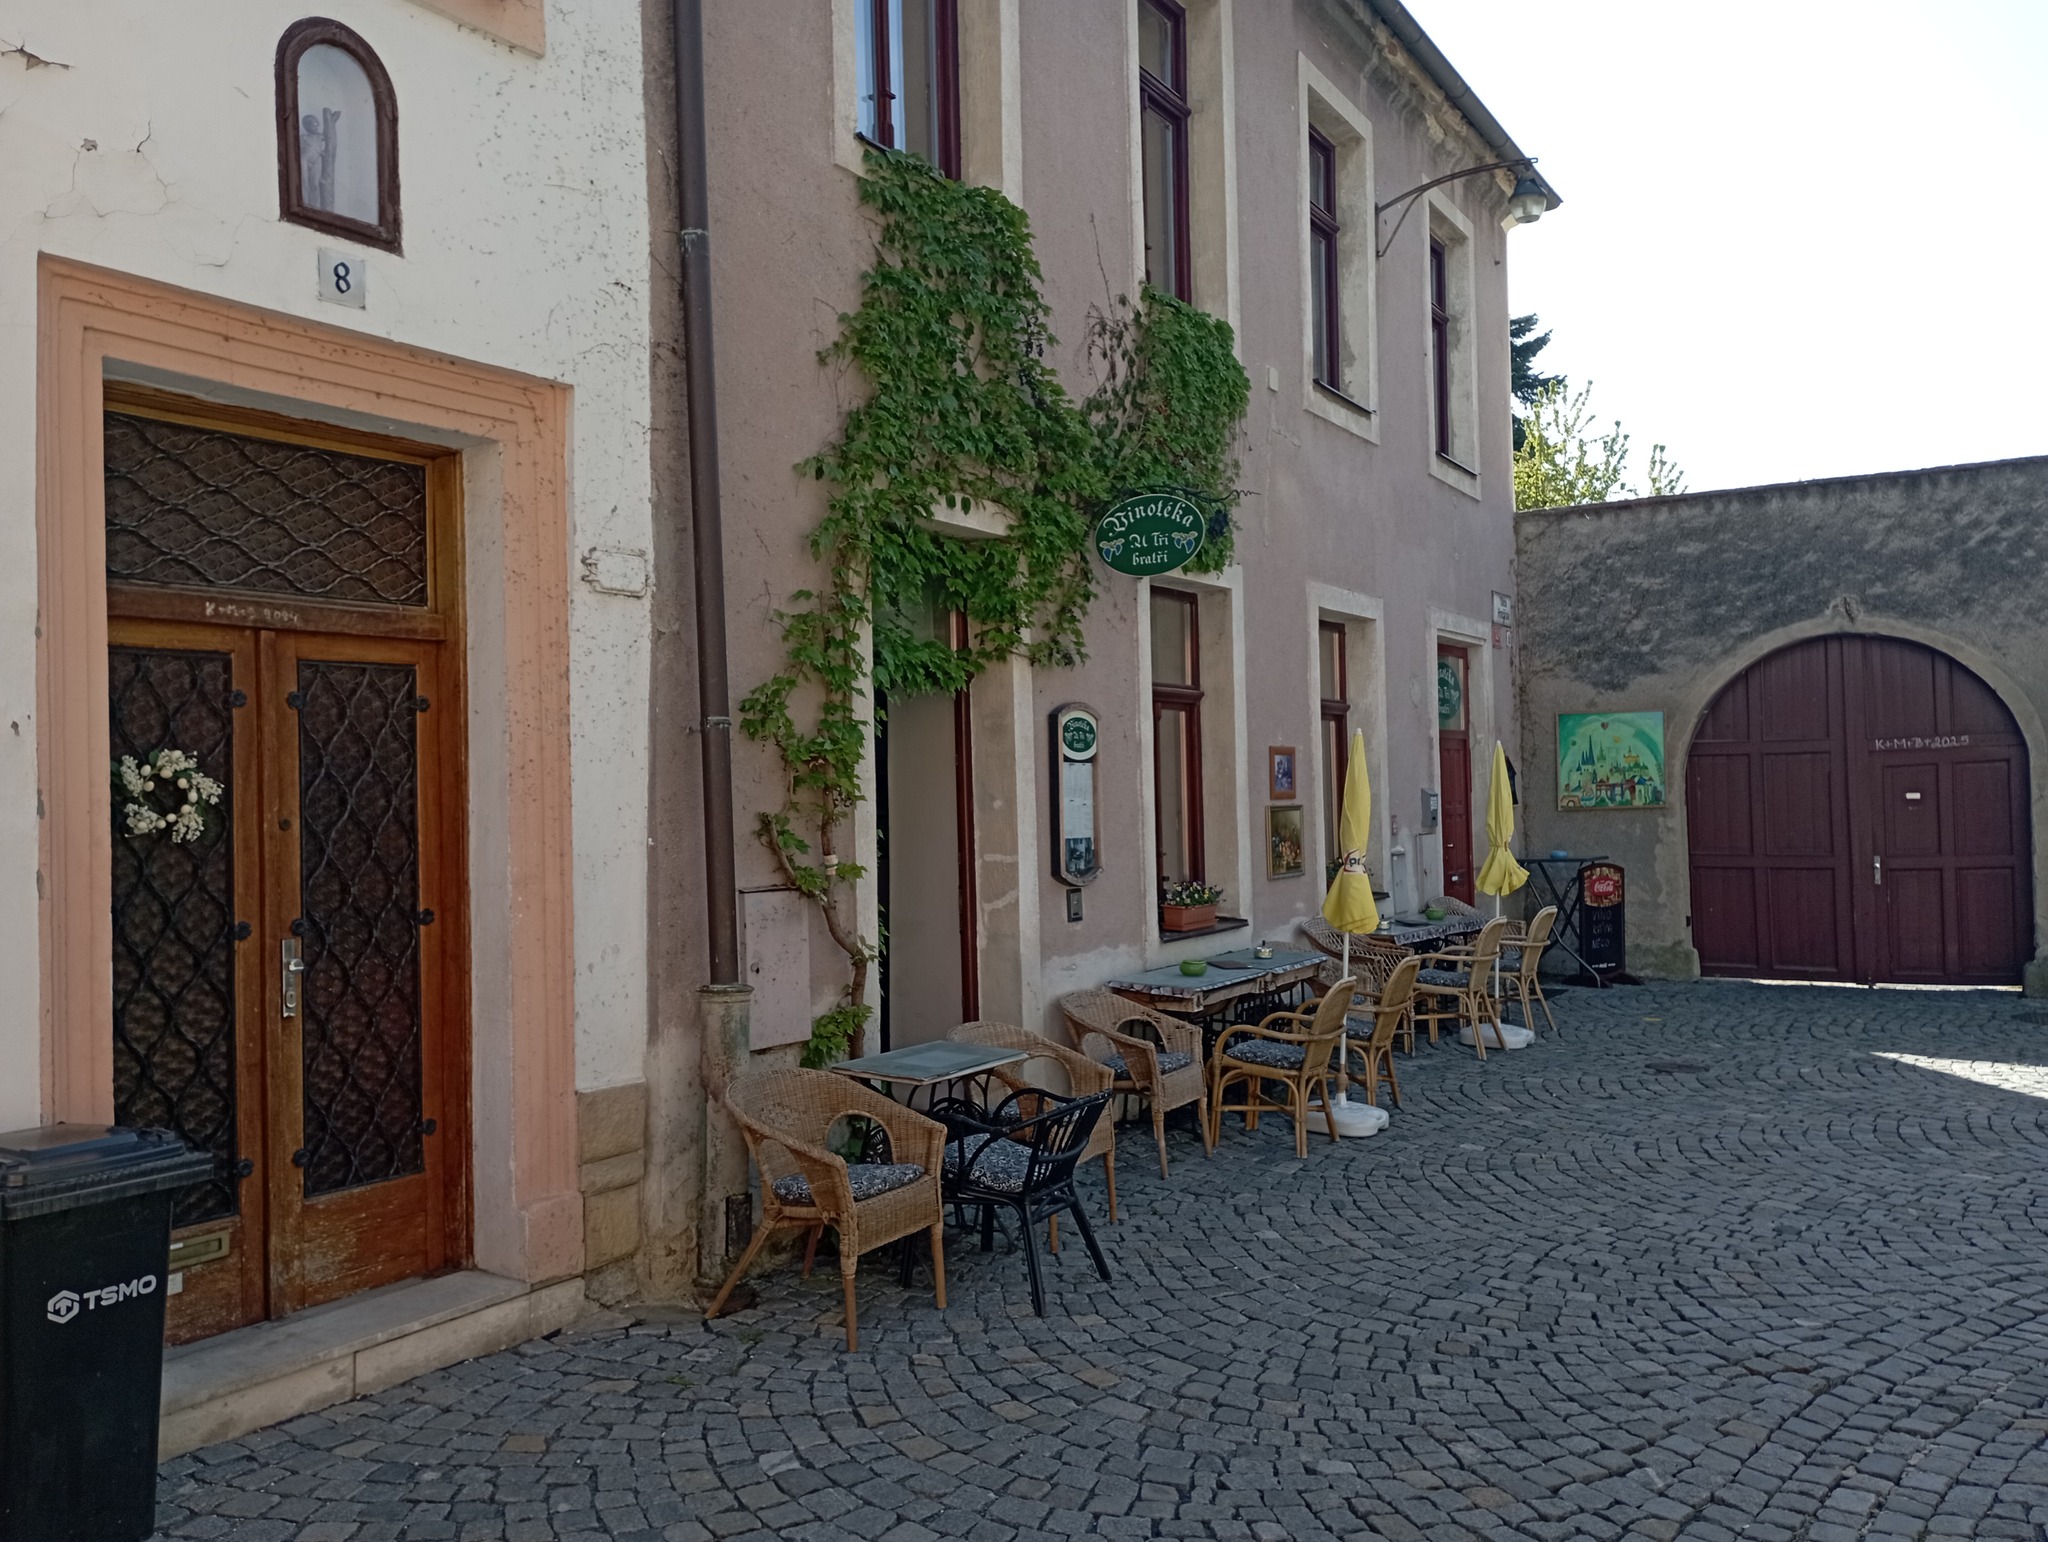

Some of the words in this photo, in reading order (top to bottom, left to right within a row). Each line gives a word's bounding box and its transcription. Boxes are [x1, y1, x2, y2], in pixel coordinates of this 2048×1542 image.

[333, 261, 351, 294] 8
[1102, 499, 1194, 537] Vinotéka
[1132, 550, 1168, 566] bratří
[83, 1274, 157, 1311] TSMO
